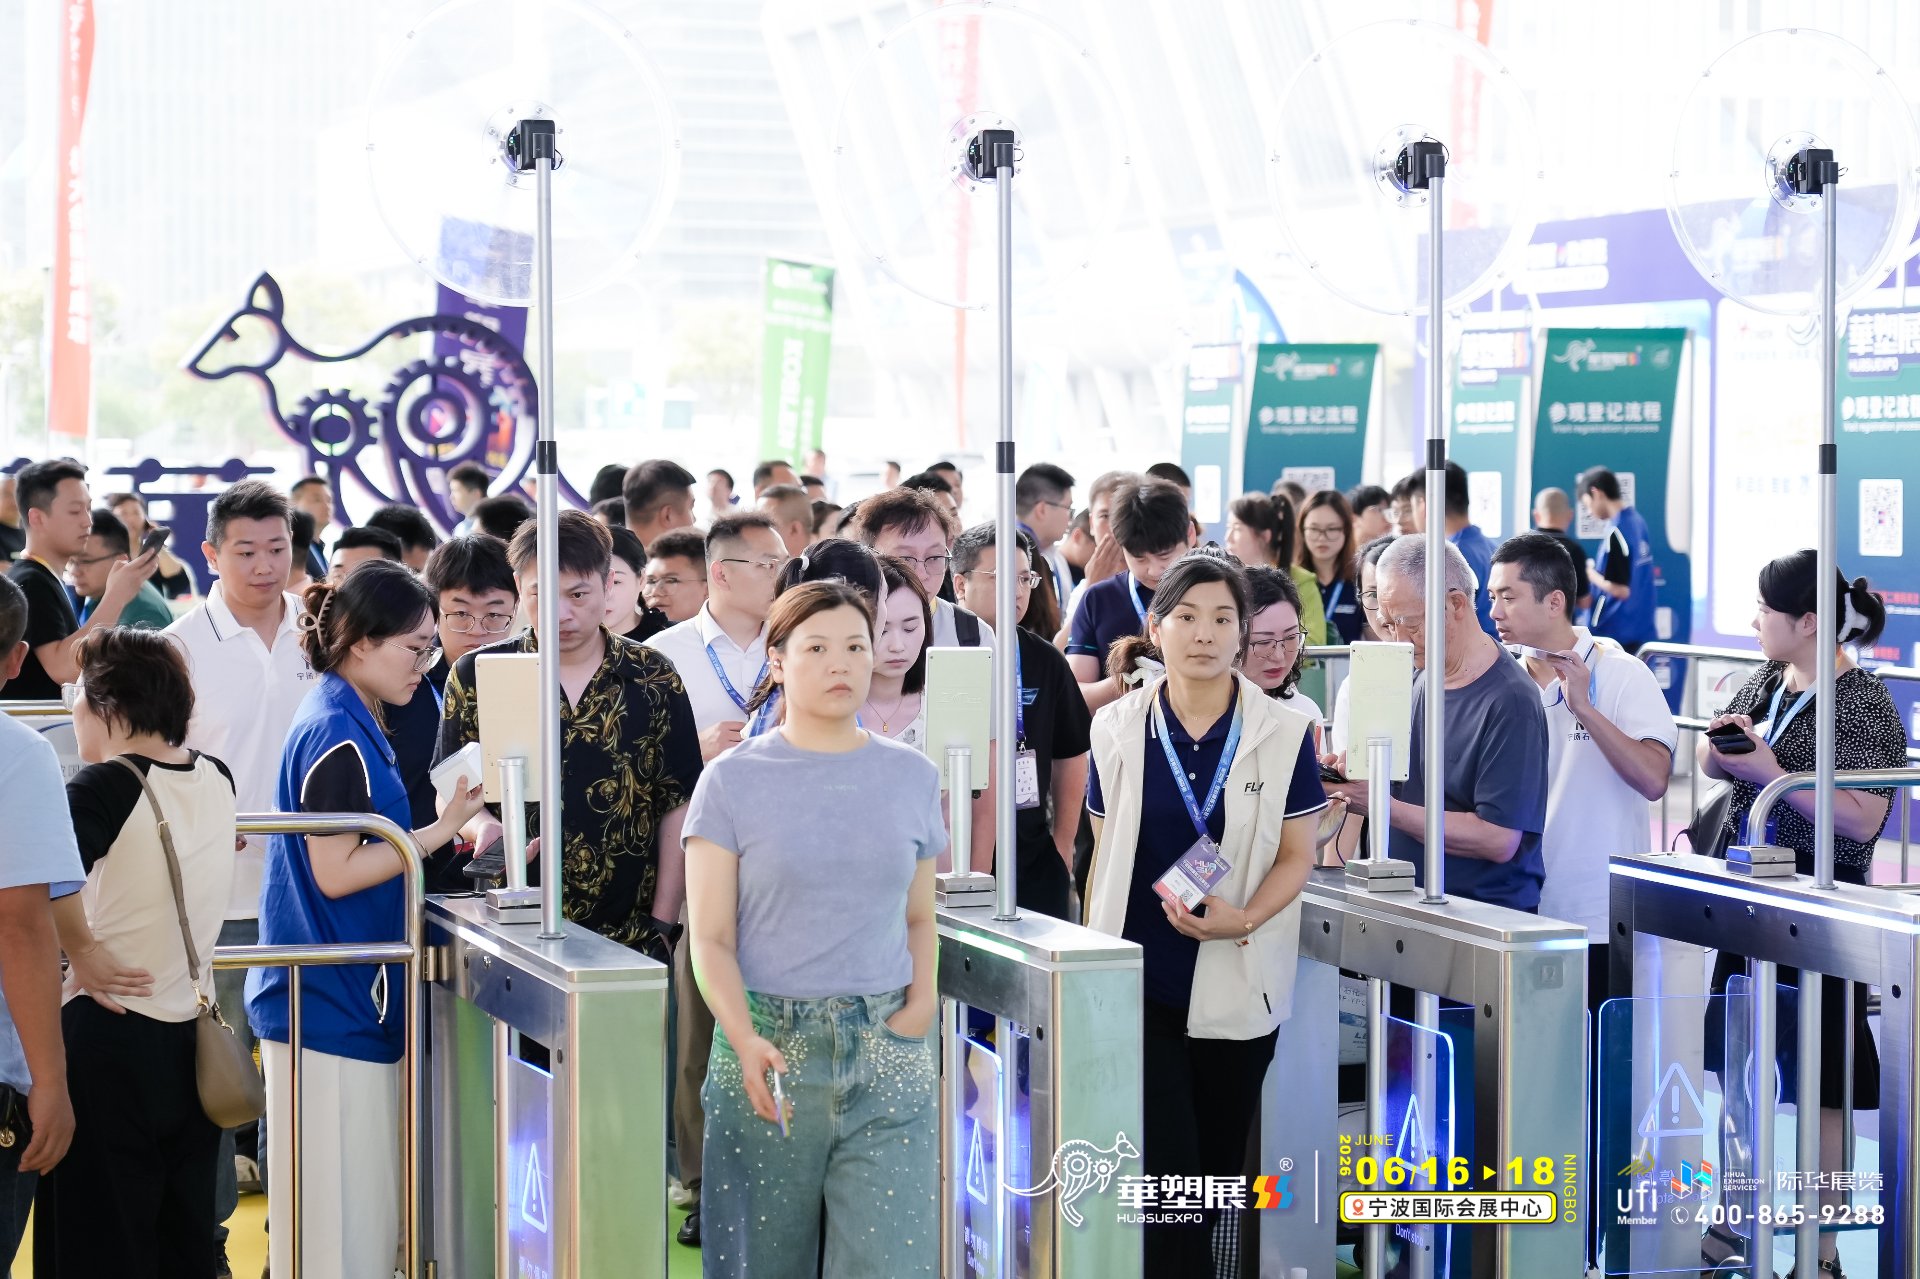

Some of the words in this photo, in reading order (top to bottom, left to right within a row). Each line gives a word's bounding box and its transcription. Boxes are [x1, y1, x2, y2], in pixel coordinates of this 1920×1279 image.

[1550, 402, 1661, 424] 参观登记流程
